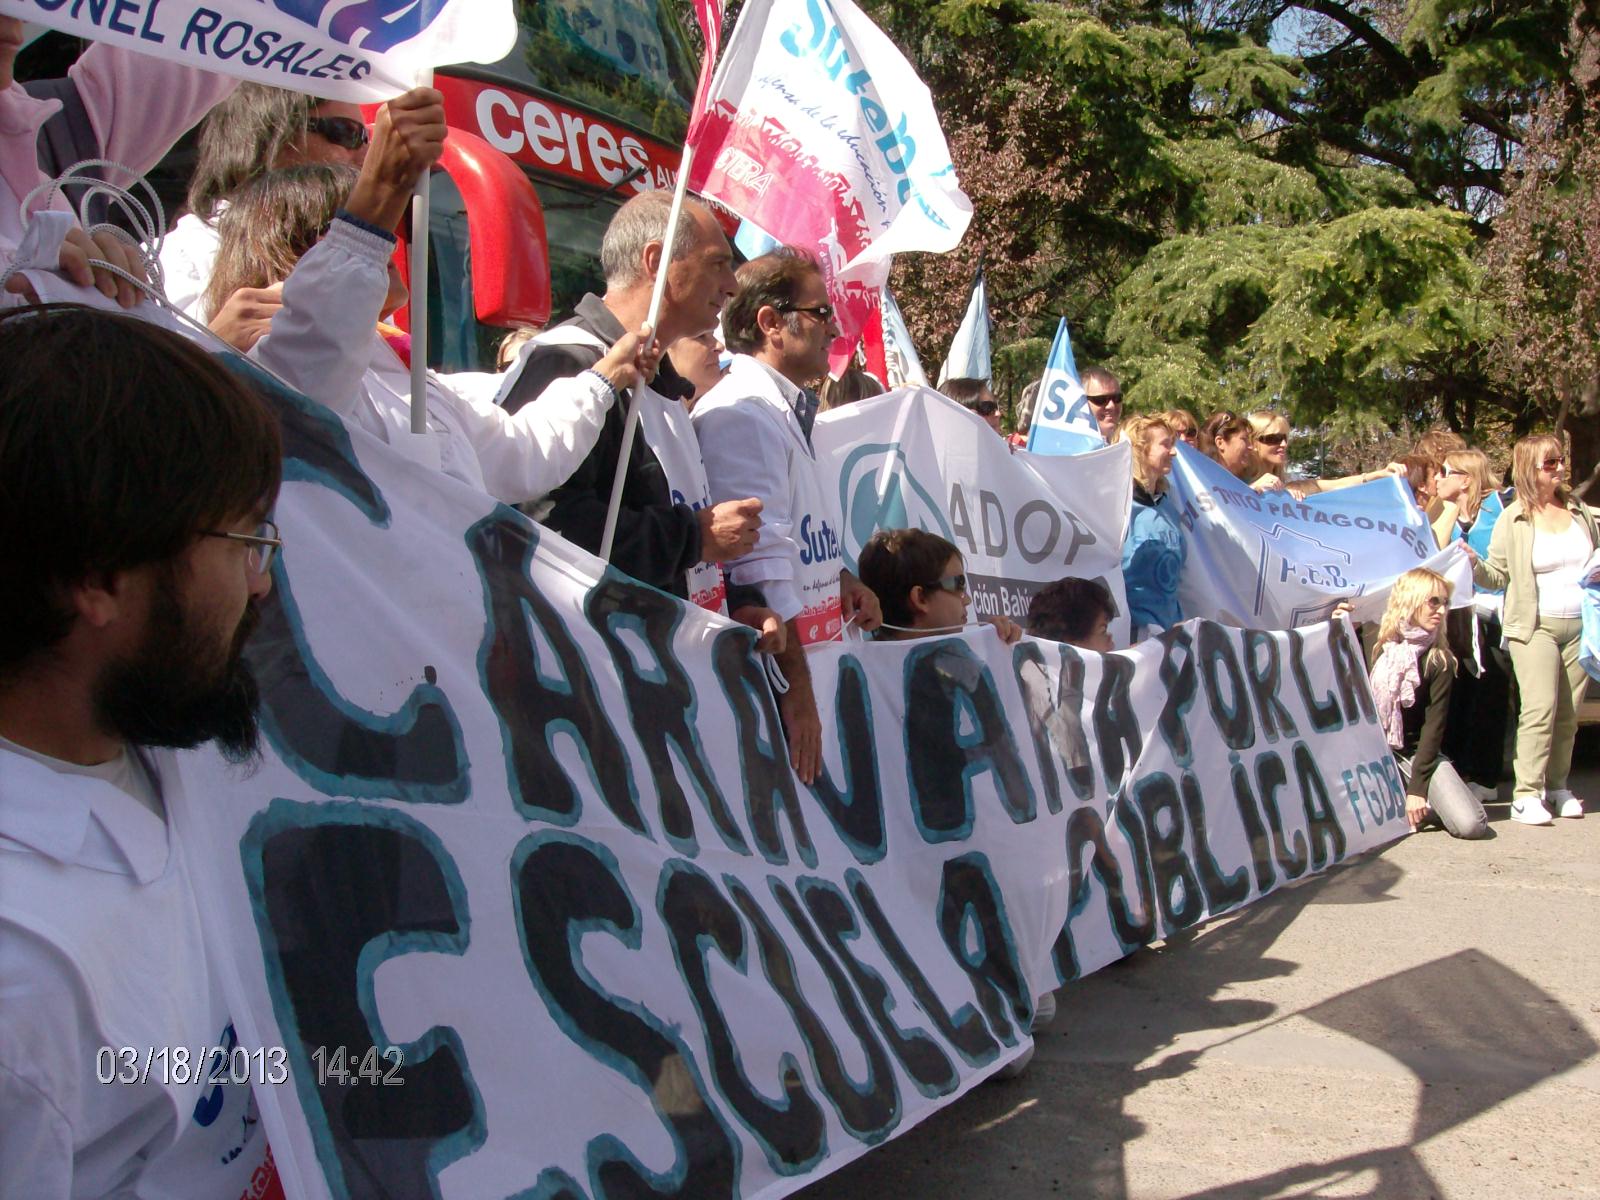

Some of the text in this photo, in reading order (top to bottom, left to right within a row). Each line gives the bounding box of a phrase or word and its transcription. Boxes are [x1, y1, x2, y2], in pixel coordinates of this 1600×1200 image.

[179, 7, 371, 80] ROSALES
[475, 88, 655, 193] ceres
[1266, 502, 1429, 559] PATAGONES
[1157, 618, 1299, 769] POR
[1288, 616, 1379, 734] LA
[240, 797, 1035, 1200] ESCUELA
